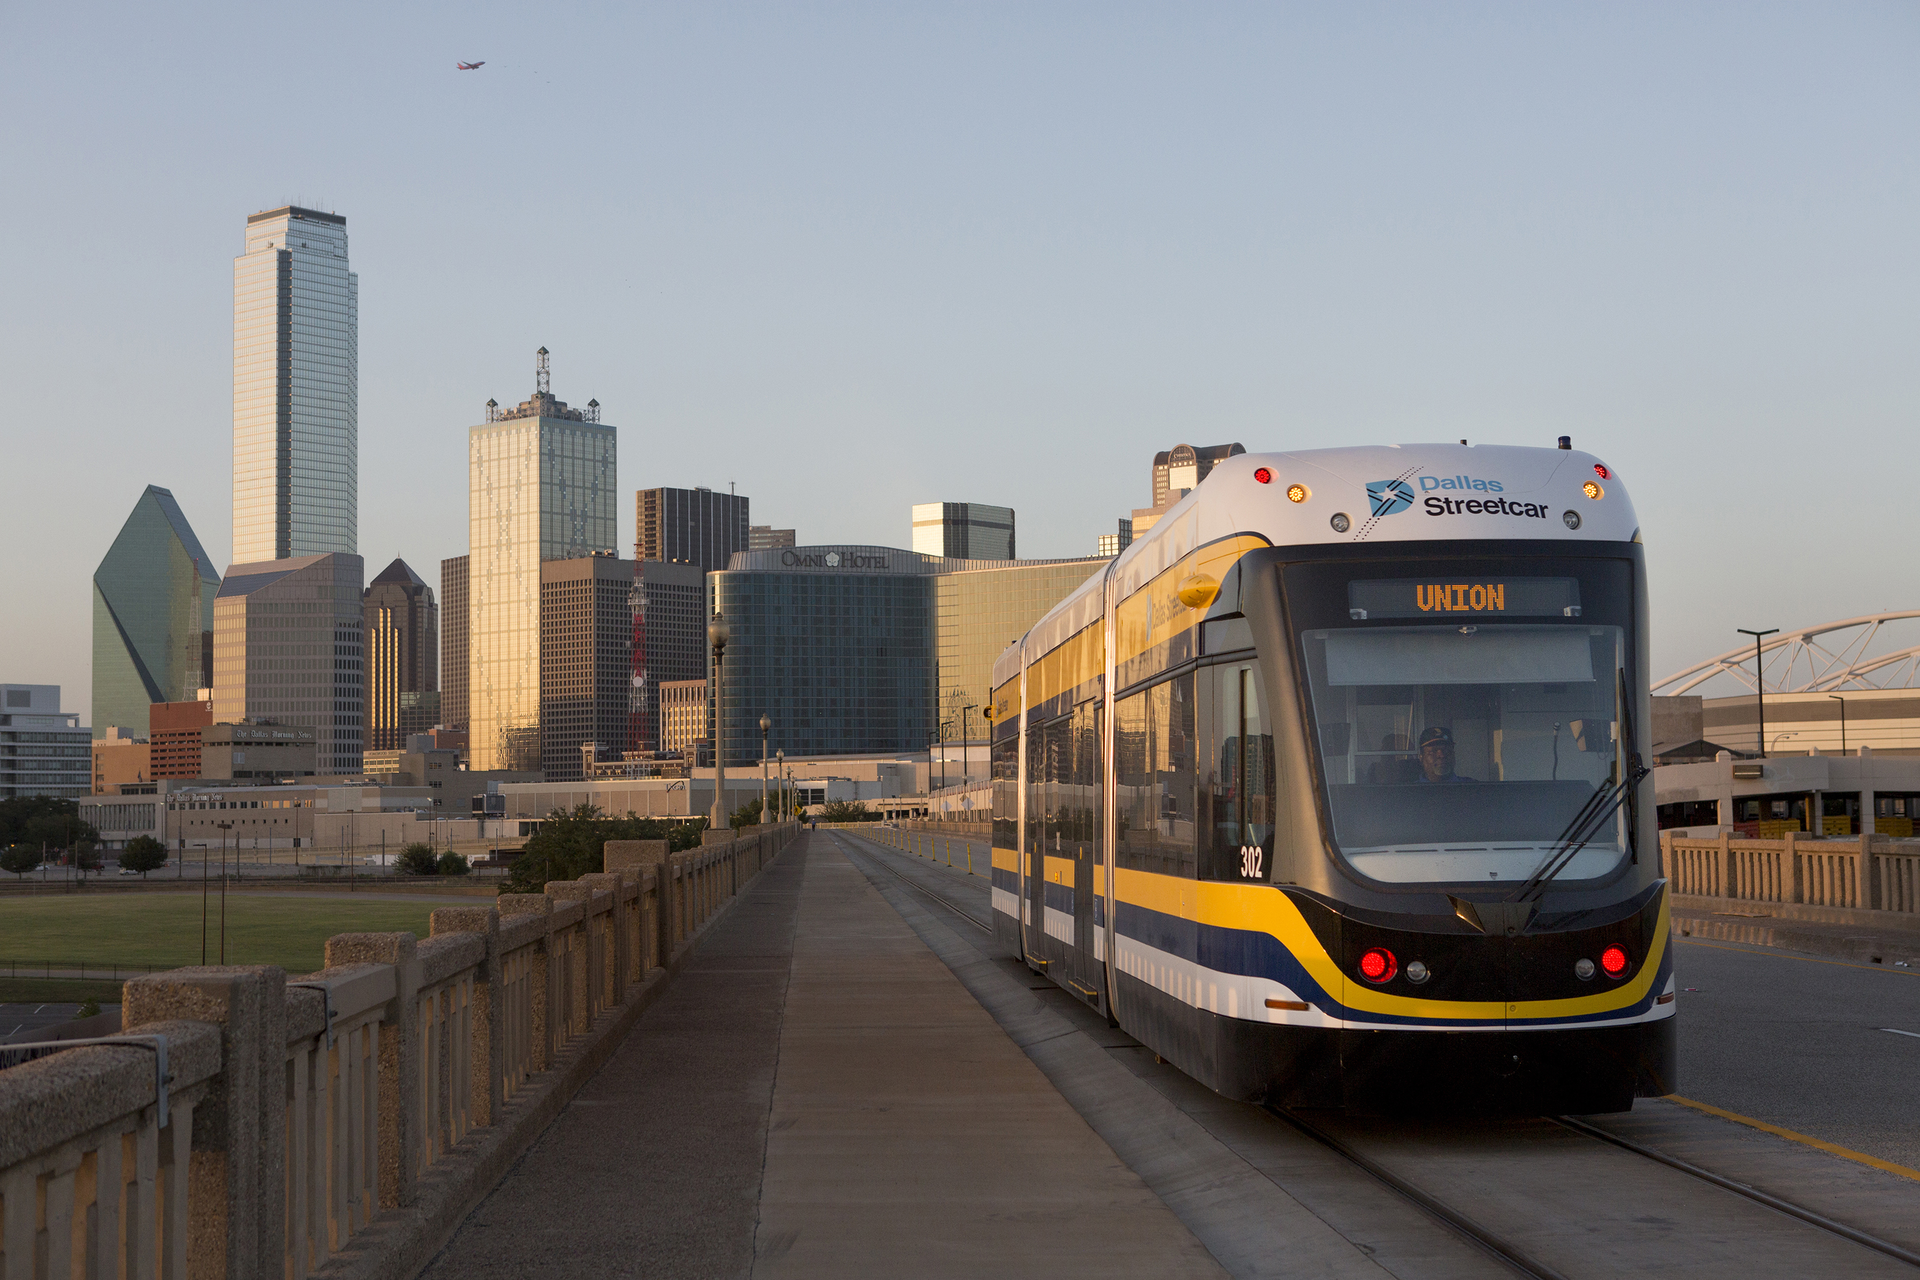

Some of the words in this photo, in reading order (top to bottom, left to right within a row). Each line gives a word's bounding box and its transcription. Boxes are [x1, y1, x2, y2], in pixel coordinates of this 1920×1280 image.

[1418, 475, 1504, 492] Dallas
[1424, 497, 1549, 519] Streetcar
[781, 550, 823, 567] OMNI
[840, 551, 889, 569] HOTEL
[1417, 584, 1505, 611] UNION
[236, 729, 247, 739] The
[250, 729, 269, 739] Dallas
[271, 730, 295, 740] Morning
[297, 730, 312, 739] News
[1240, 845, 1263, 878] 302
